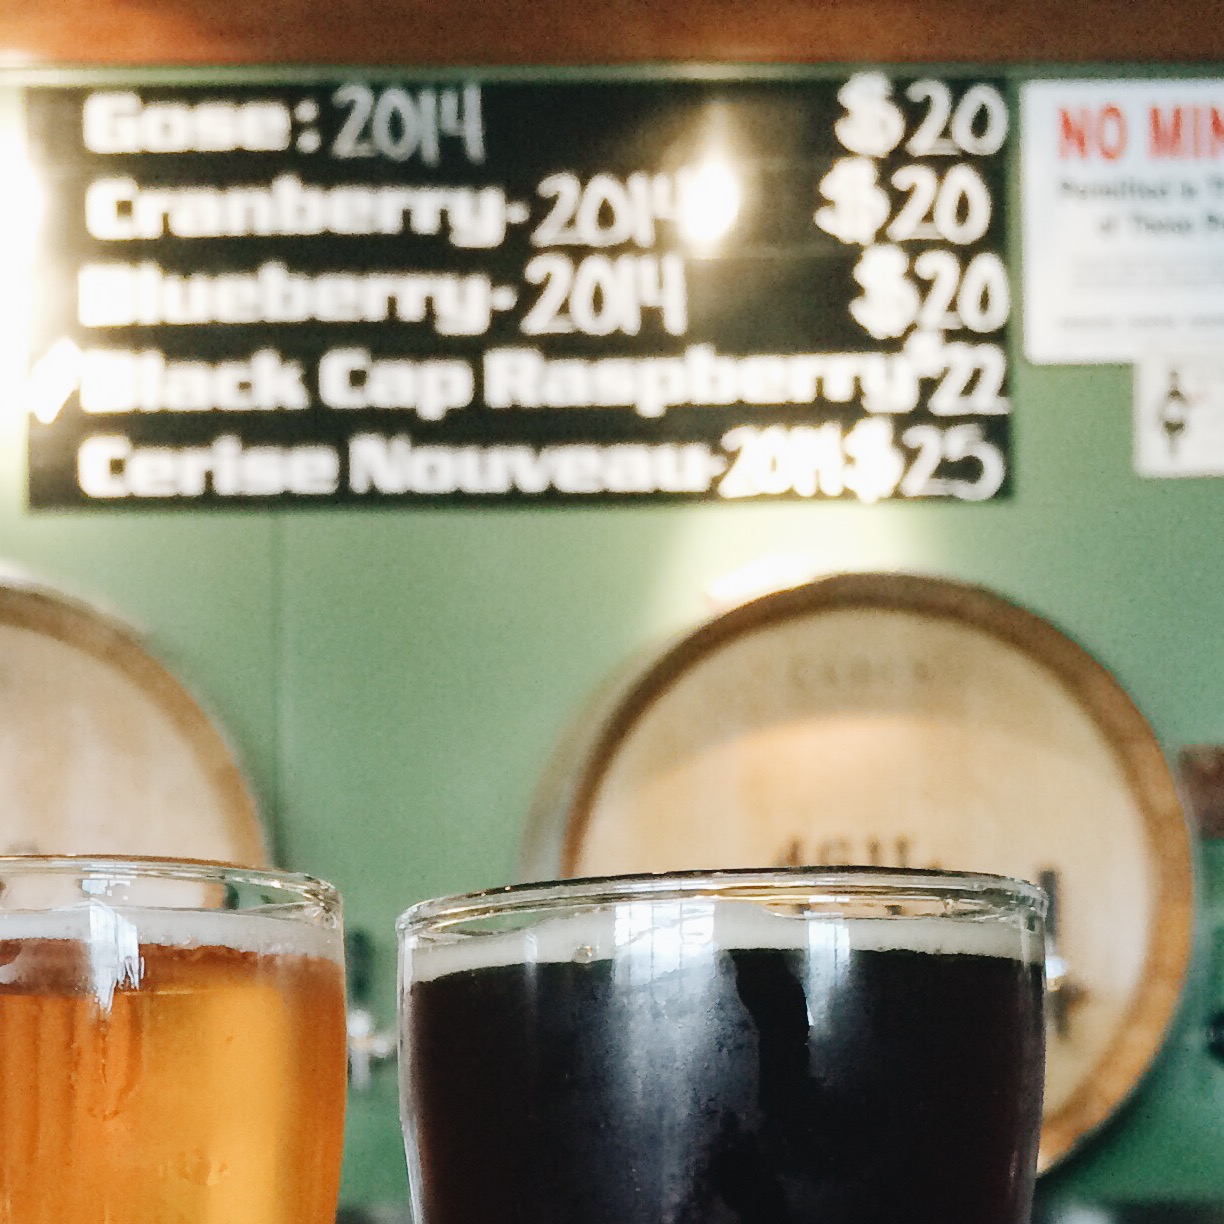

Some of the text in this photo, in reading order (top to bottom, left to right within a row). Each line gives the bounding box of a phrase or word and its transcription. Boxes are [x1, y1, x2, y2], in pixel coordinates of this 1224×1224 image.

[331, 84, 487, 165] 2014
[834, 72, 1009, 157] $20
[1058, 104, 1127, 162] NO
[813, 156, 992, 245] $20
[520, 252, 689, 336] 2014
[849, 244, 1011, 340] $20
[78, 346, 311, 414] Black
[318, 347, 475, 421] Cap
[482, 343, 920, 418] Raspberry
[77, 434, 340, 498] Cerise
[842, 415, 1007, 502] $25
